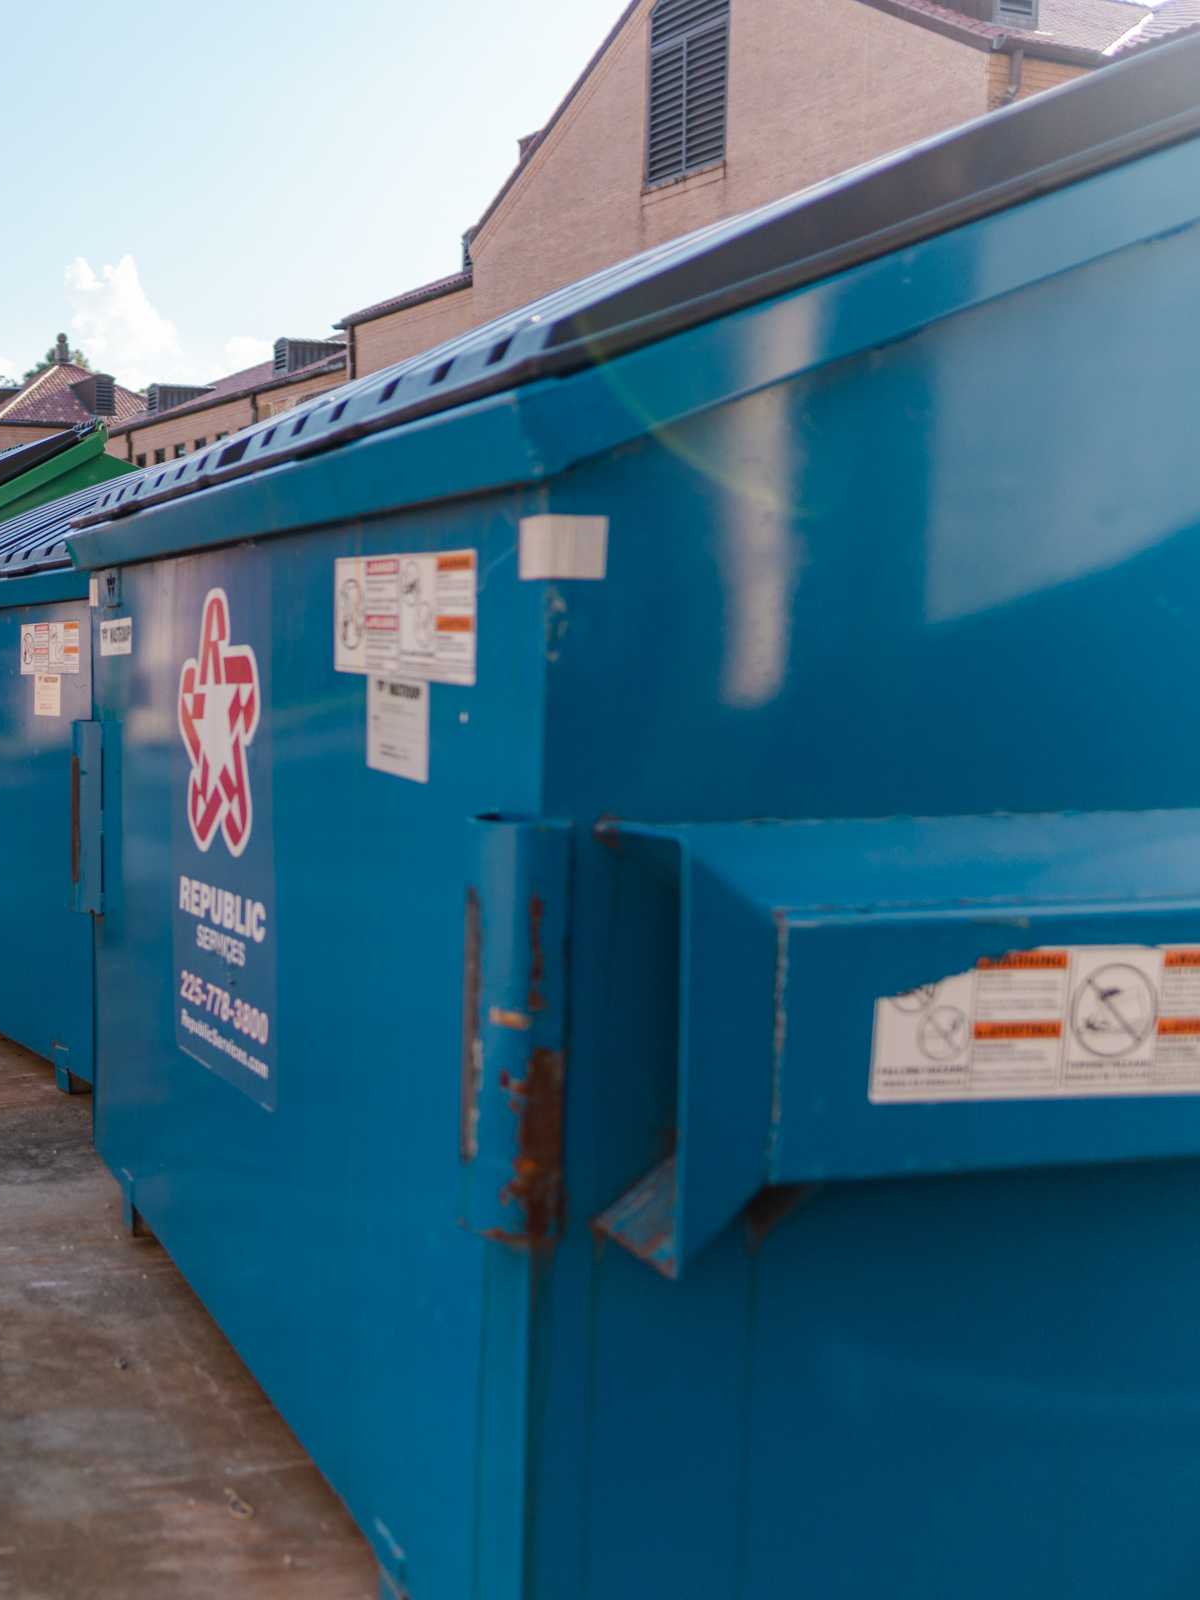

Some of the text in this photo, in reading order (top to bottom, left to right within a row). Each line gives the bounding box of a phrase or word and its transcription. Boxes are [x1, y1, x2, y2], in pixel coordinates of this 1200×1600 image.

[179, 875, 266, 943] REPUBLIC
[196, 923, 246, 967] SERVICES
[180, 969, 269, 1045] 225-778-3800
[181, 1008, 269, 1079] RepublicServices.com
